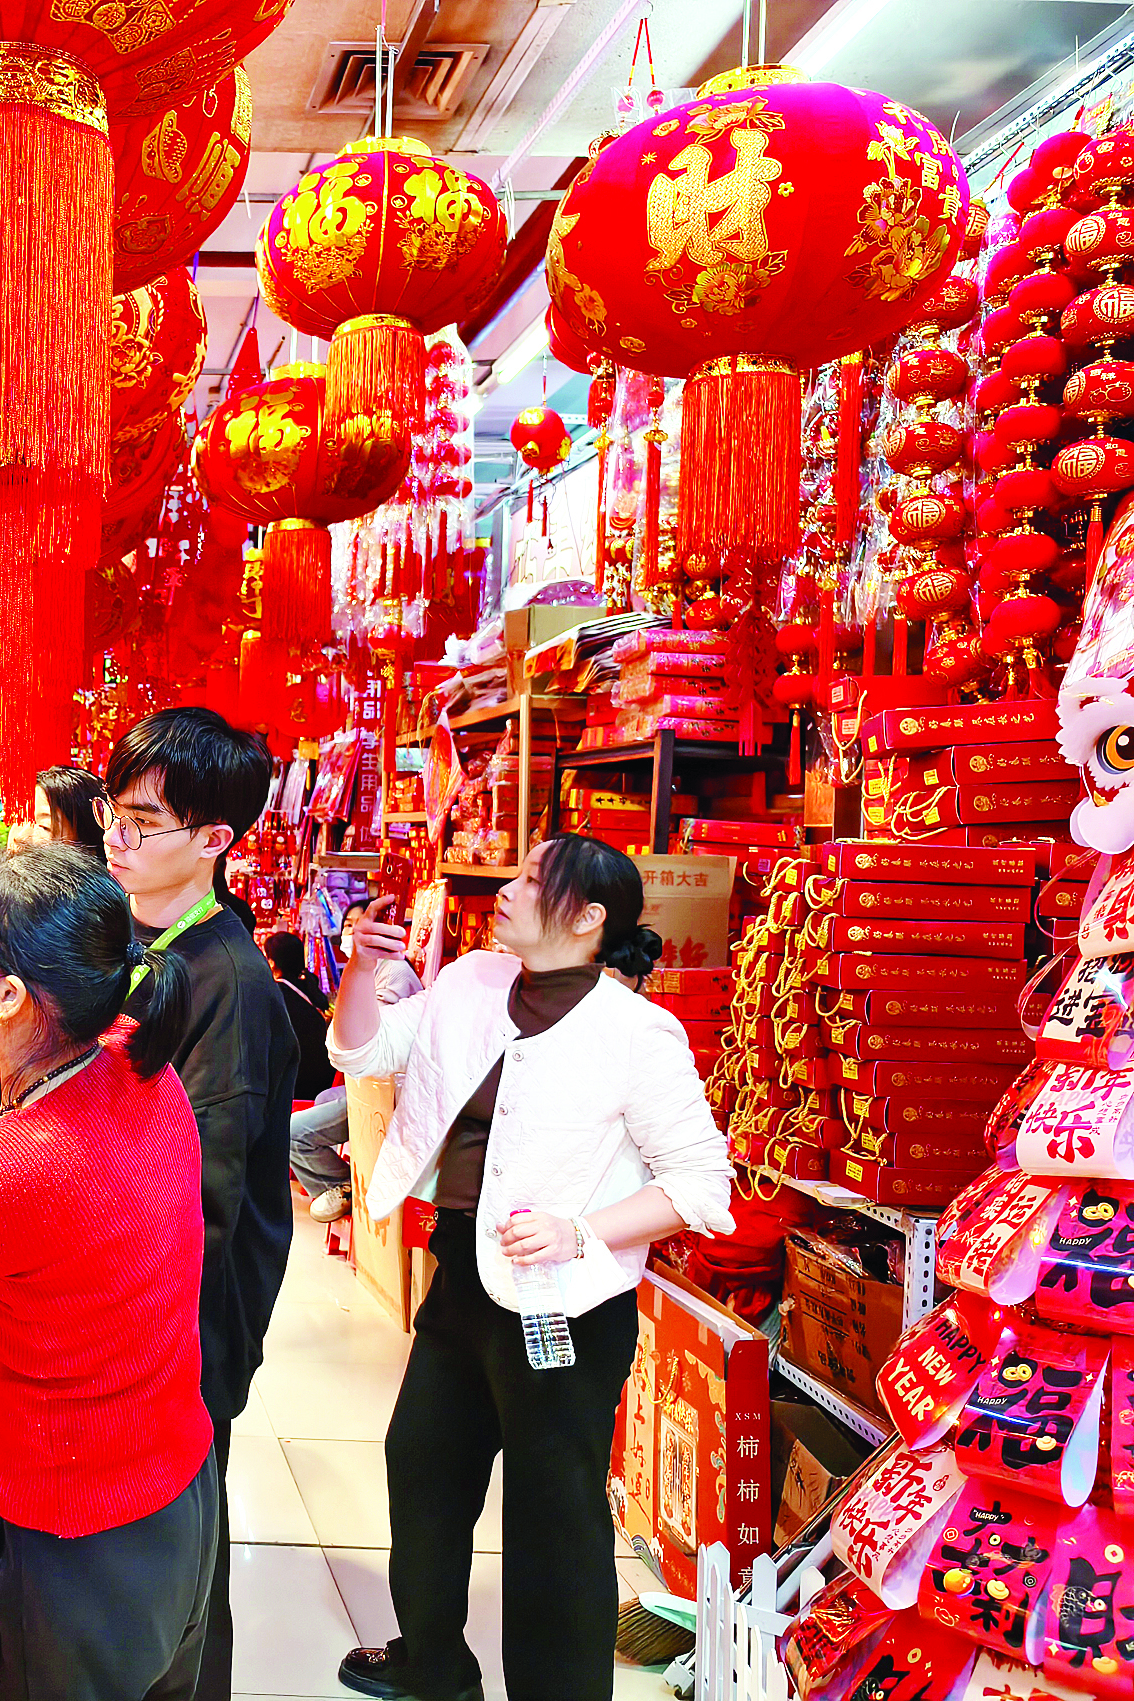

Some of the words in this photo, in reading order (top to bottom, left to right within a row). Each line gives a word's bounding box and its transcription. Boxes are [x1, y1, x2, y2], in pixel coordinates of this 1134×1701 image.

[284, 161, 369, 249] 福
[404, 156, 483, 233] 福
[1068, 216, 1099, 254] 福
[227, 387, 303, 463] 福
[1061, 446, 1097, 479] 福
[906, 502, 941, 526] 福
[919, 575, 954, 601] 福
[643, 870, 709, 887] 开箱大吉
[1026, 1101, 1097, 1163] 快乐
[1059, 1236, 1092, 1247] HAPPY
[918, 1345, 957, 1387] NEW
[935, 1318, 988, 1375] HAPPY
[887, 1358, 935, 1422] YEAR
[977, 1396, 1007, 1406] HAPPY
[874, 1453, 933, 1525] 新年
[838, 1497, 892, 1580] 快乐
